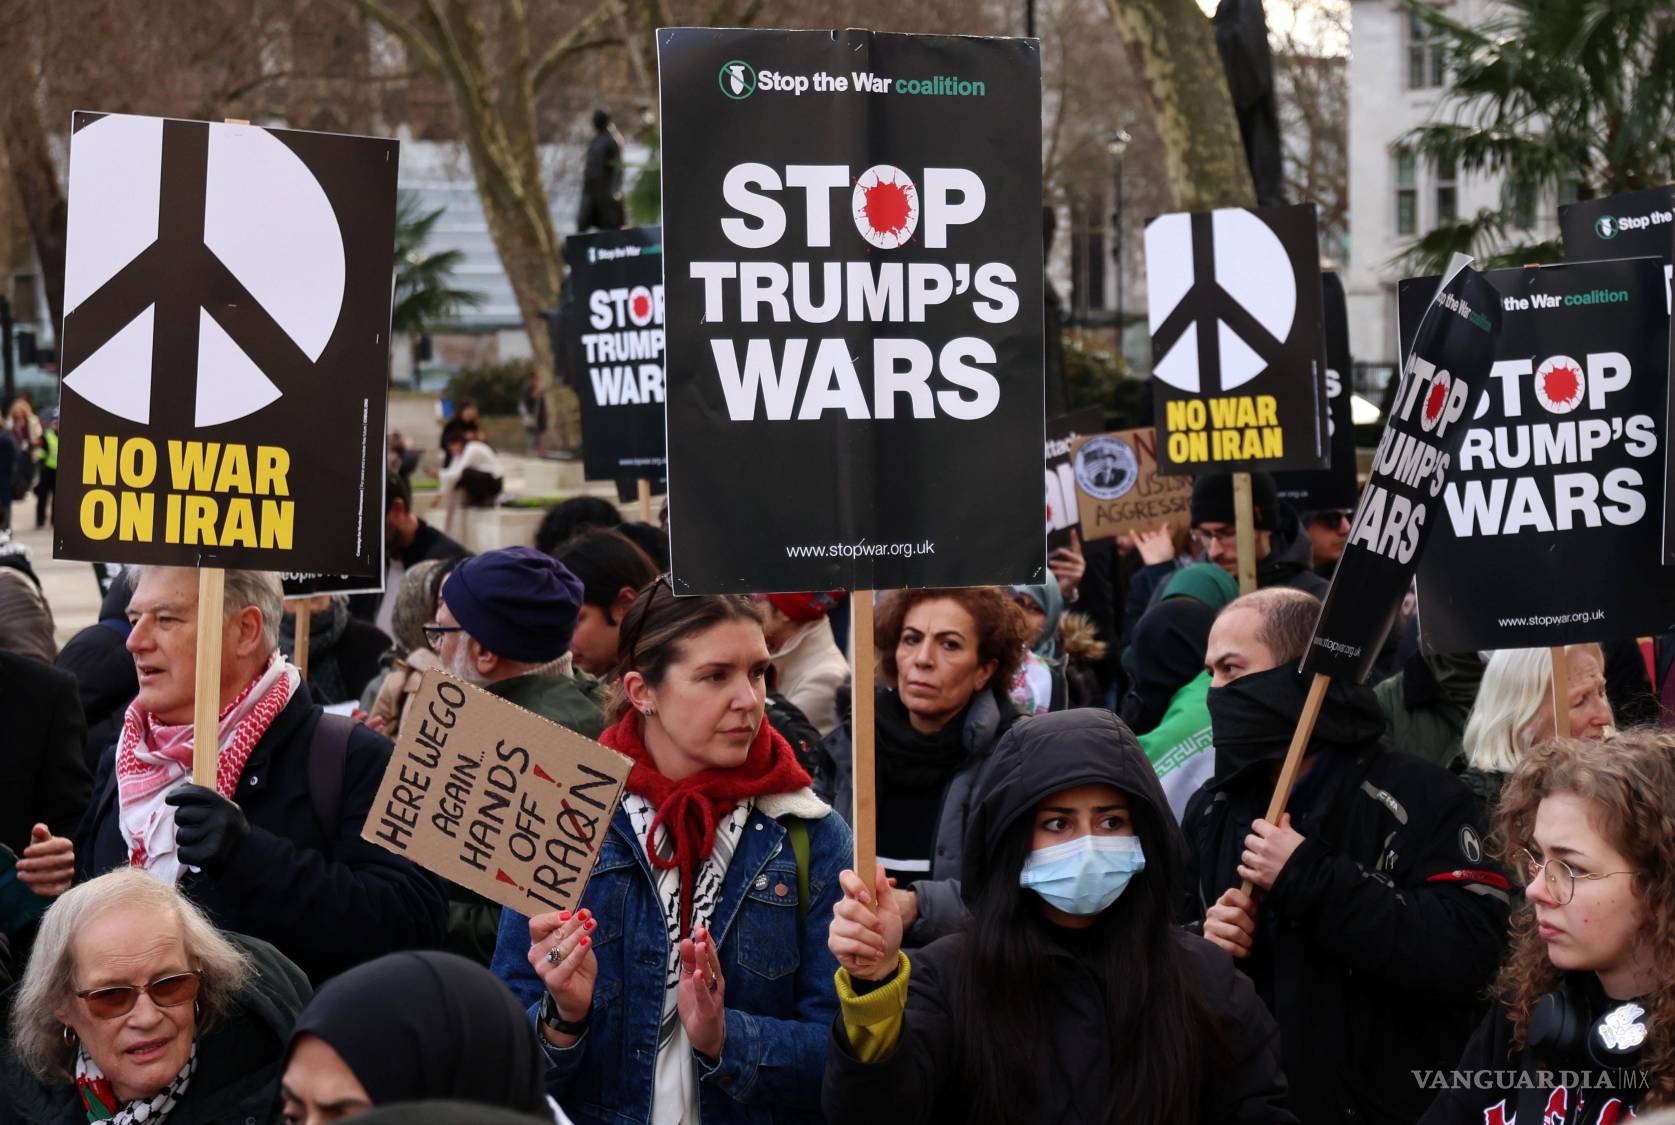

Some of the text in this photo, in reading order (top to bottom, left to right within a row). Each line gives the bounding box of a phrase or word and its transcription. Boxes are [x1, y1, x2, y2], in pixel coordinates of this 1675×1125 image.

[758, 71, 986, 97] Stop the War coalition
[720, 162, 986, 249] STOP
[1618, 211, 1672, 231] Stop the
[690, 262, 1019, 324] TRUMP'S
[1504, 289, 1629, 311] the War coalition
[581, 330, 664, 363] TRUMP
[589, 364, 664, 406] WAR
[710, 337, 1000, 421] WARS
[1473, 352, 1633, 421] TOP
[1166, 395, 1281, 432] NO WAR
[1459, 414, 1658, 471] RUMP'S
[83, 435, 291, 497] NO WAR
[1168, 427, 1284, 464] ON IRAN
[80, 489, 295, 550] ON IRAN
[1348, 483, 1426, 564] ARS
[1443, 467, 1646, 538] WARS
[786, 538, 935, 560] www.stopwar.org.uk
[1499, 609, 1606, 628] www.stopwar.org.uk
[376, 764, 431, 850] HERE
[459, 739, 530, 872] HANDS
[509, 792, 546, 863] OFF
